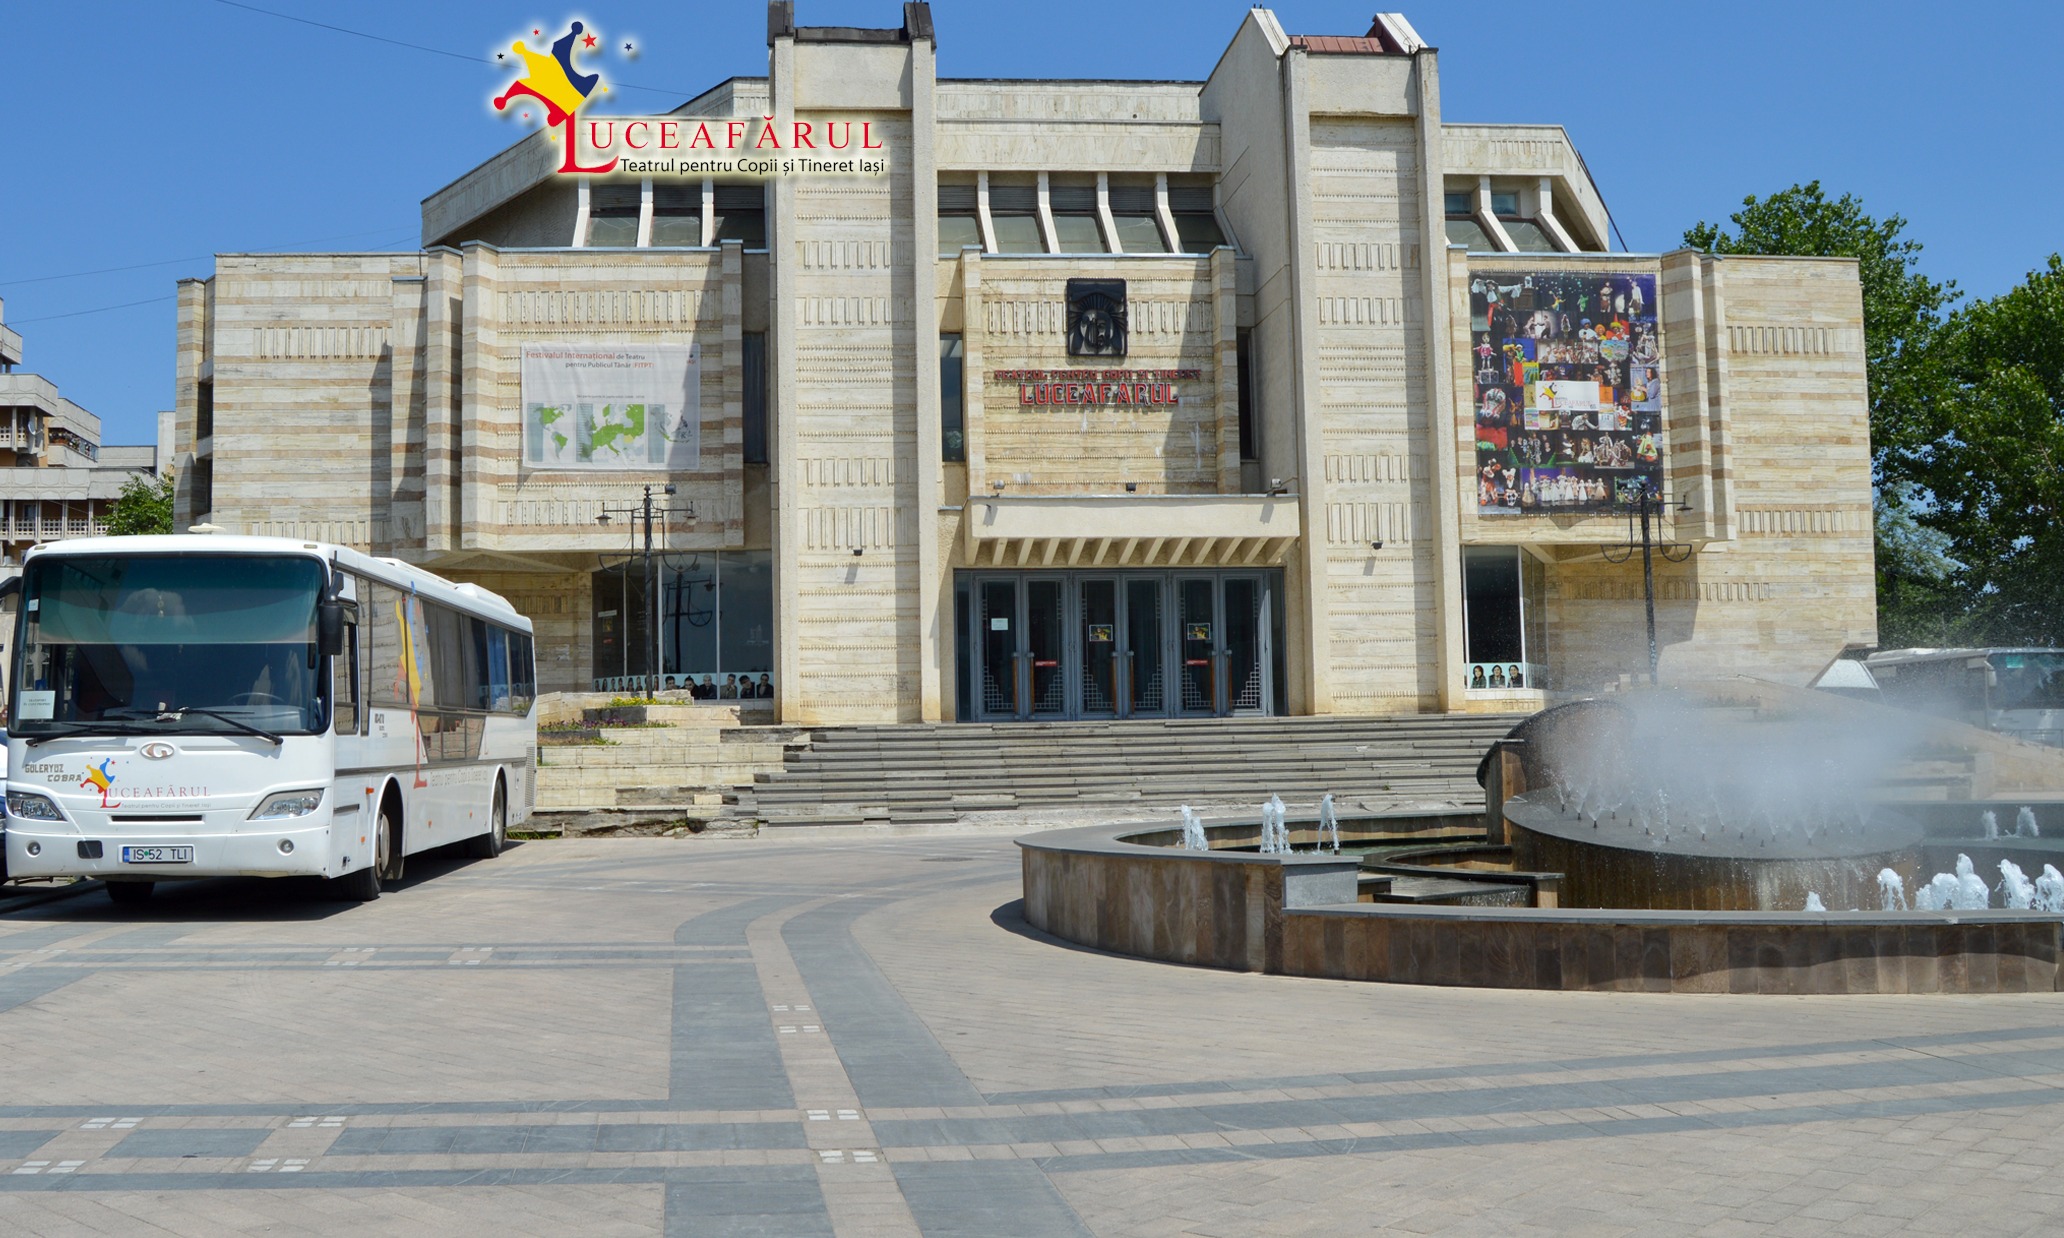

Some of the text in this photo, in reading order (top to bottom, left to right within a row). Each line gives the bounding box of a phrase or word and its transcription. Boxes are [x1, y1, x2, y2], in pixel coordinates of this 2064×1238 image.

[525, 351, 563, 359] Festivalul
[588, 361, 613, 369] Publicul
[47, 774, 82, 783] COBRA
[133, 849, 187, 860] IS 52 TLI
